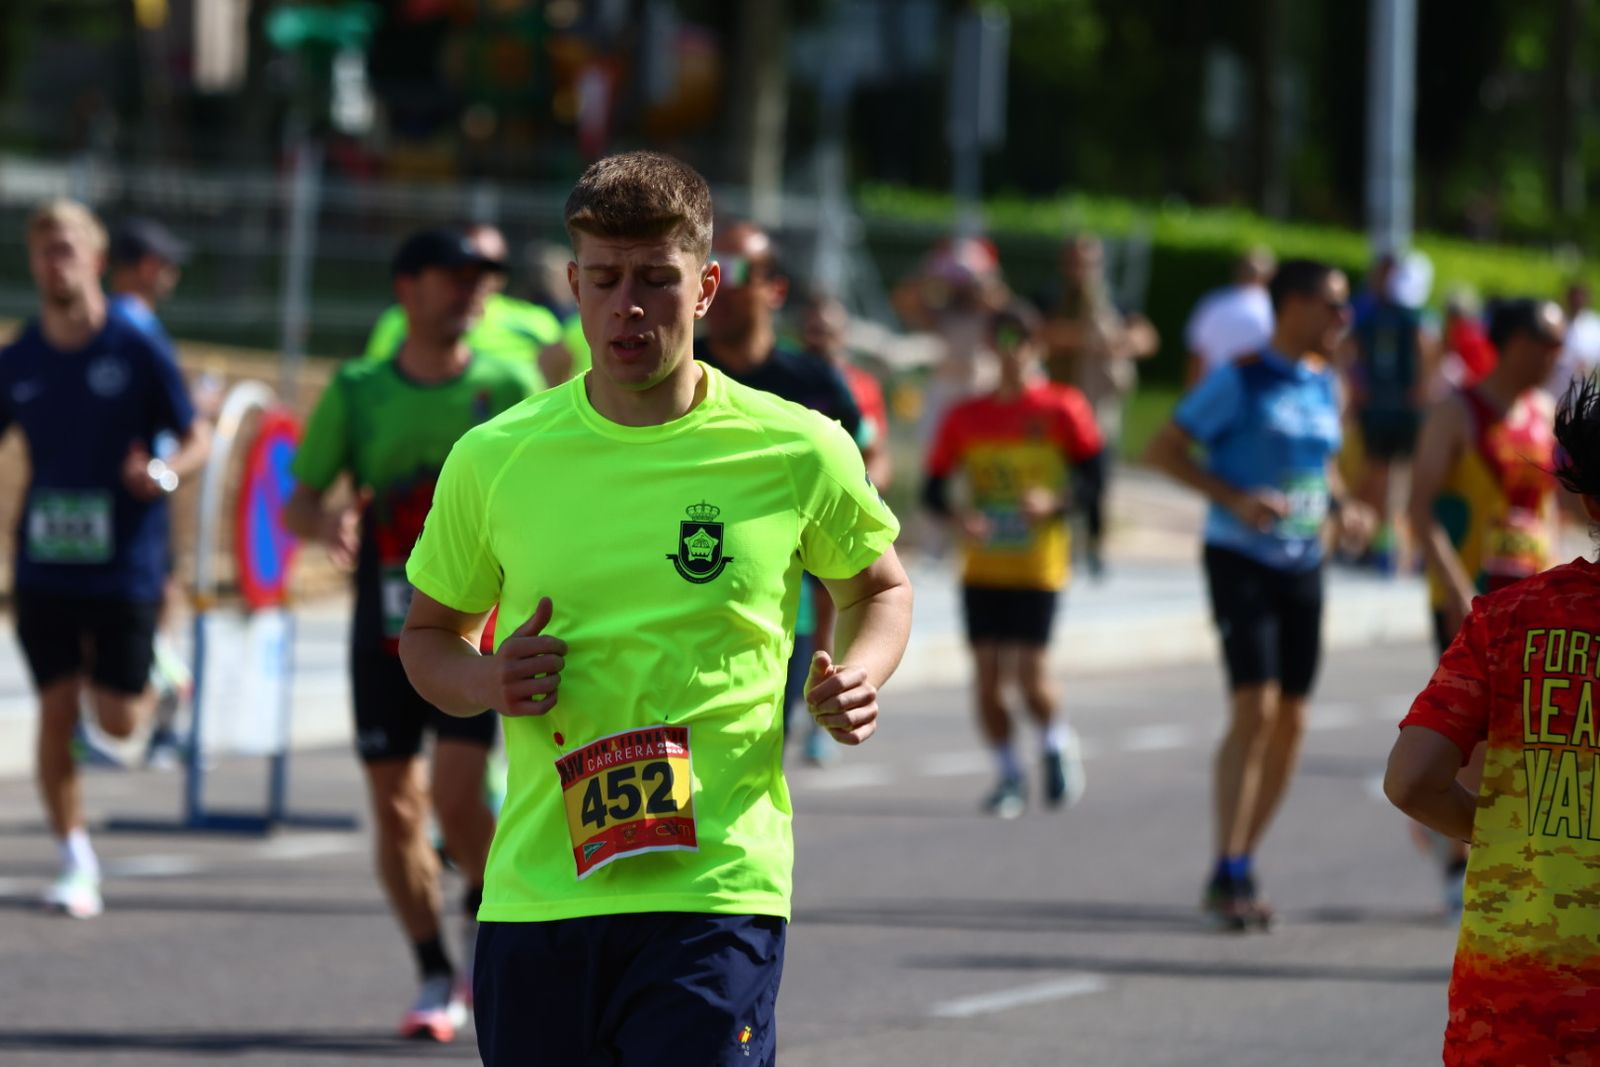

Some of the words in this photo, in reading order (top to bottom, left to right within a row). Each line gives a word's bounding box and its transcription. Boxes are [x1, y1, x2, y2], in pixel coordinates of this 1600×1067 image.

[1522, 628, 1600, 678] FOR
[1522, 677, 1600, 748] LEA
[587, 744, 654, 771] CARRERA
[581, 761, 678, 829] 452
